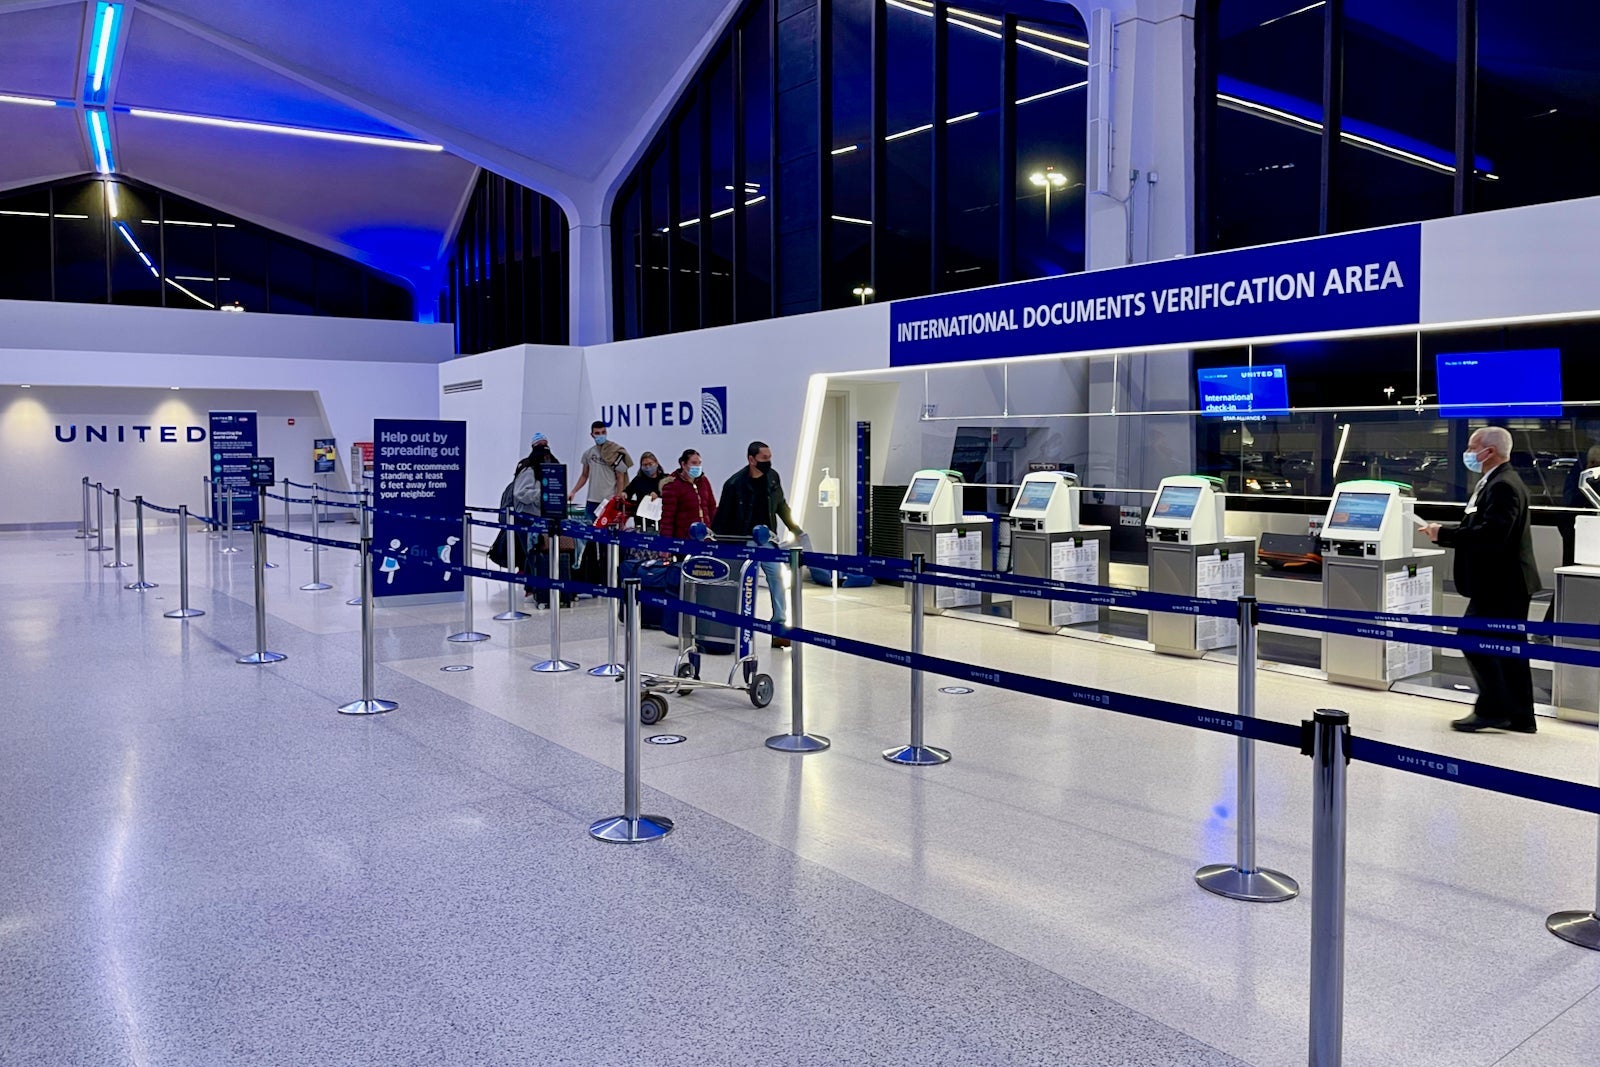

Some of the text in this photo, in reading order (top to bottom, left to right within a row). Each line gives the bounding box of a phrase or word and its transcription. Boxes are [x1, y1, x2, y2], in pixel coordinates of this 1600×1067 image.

[898, 260, 1404, 342] INTERNATIONAL DOCUMENTS VERIFICATION AREA
[1205, 393, 1254, 402] International
[601, 401, 693, 428] UNITED
[55, 425, 207, 442] UNITED
[381, 432, 448, 444] Help out by
[381, 445, 438, 458] spreading
[440, 446, 459, 456] out
[413, 463, 459, 471] recommends
[380, 472, 413, 481] standing
[388, 481, 404, 489] feet
[400, 490, 435, 499] neighbor.
[1357, 628, 1385, 636] UNITED
[1479, 643, 1511, 652] UNITED
[970, 671, 993, 680] UNITED
[1072, 691, 1100, 701] UNITED
[1198, 715, 1233, 727] UNITED
[1397, 754, 1445, 770] UNITED
